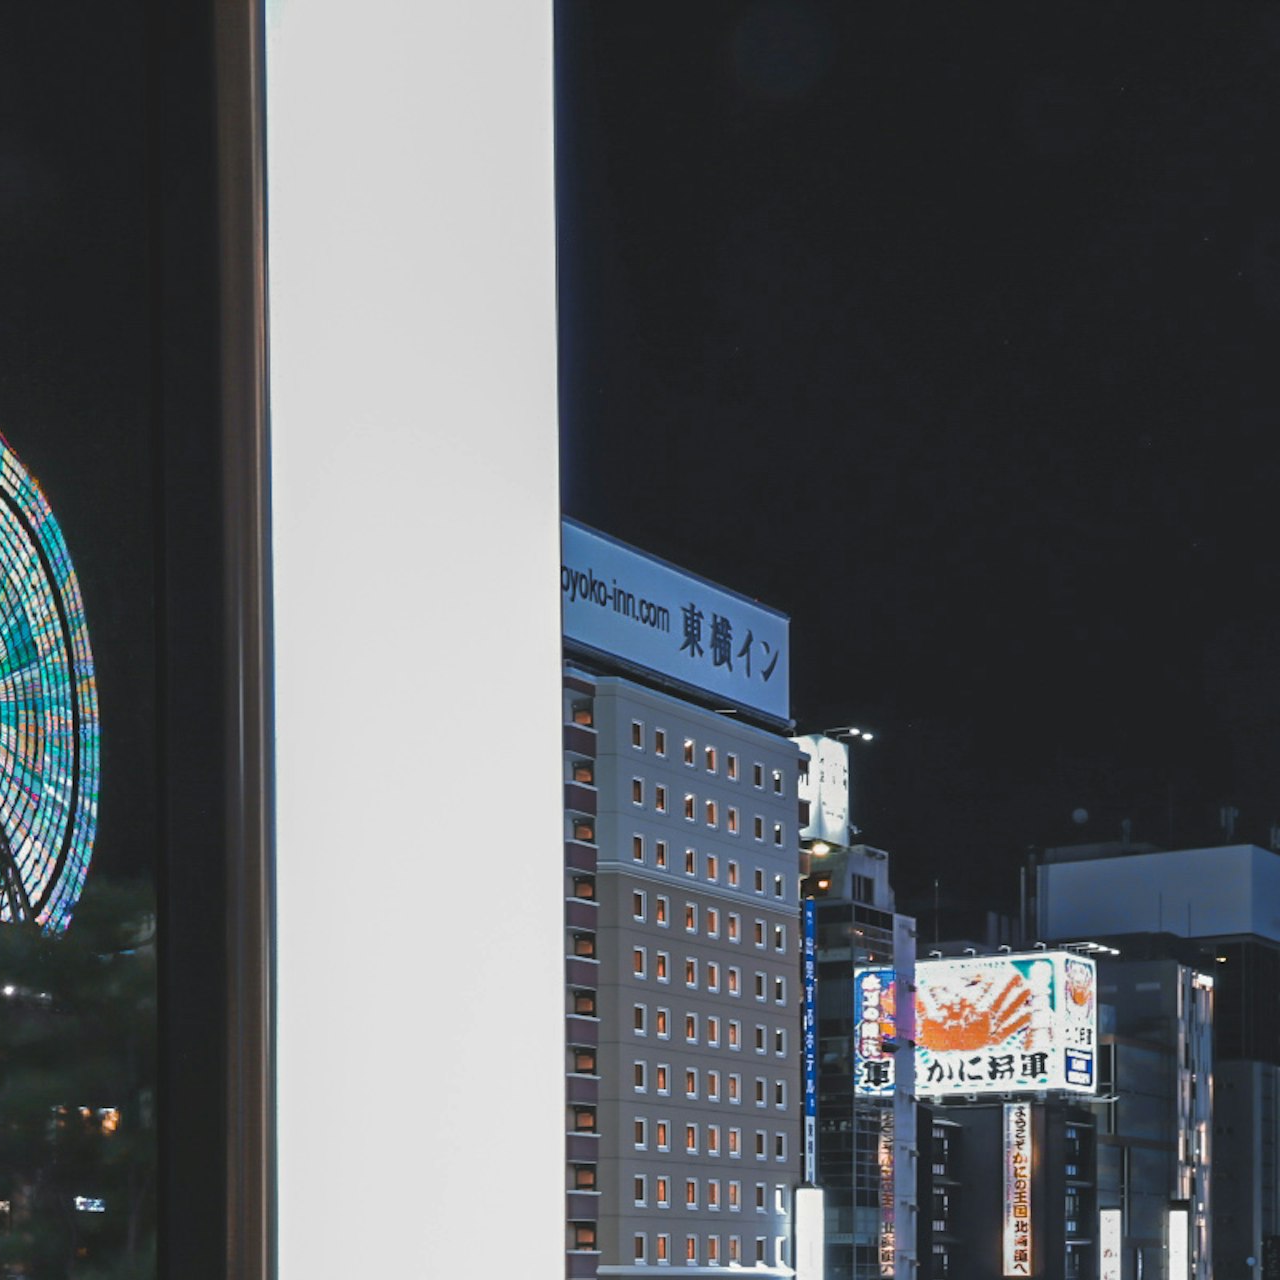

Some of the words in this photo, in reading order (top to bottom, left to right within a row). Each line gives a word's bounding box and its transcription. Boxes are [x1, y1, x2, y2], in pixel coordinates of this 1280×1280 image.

[679, 602, 781, 683] 東横イン
[927, 1051, 1050, 1083] かに将軍
